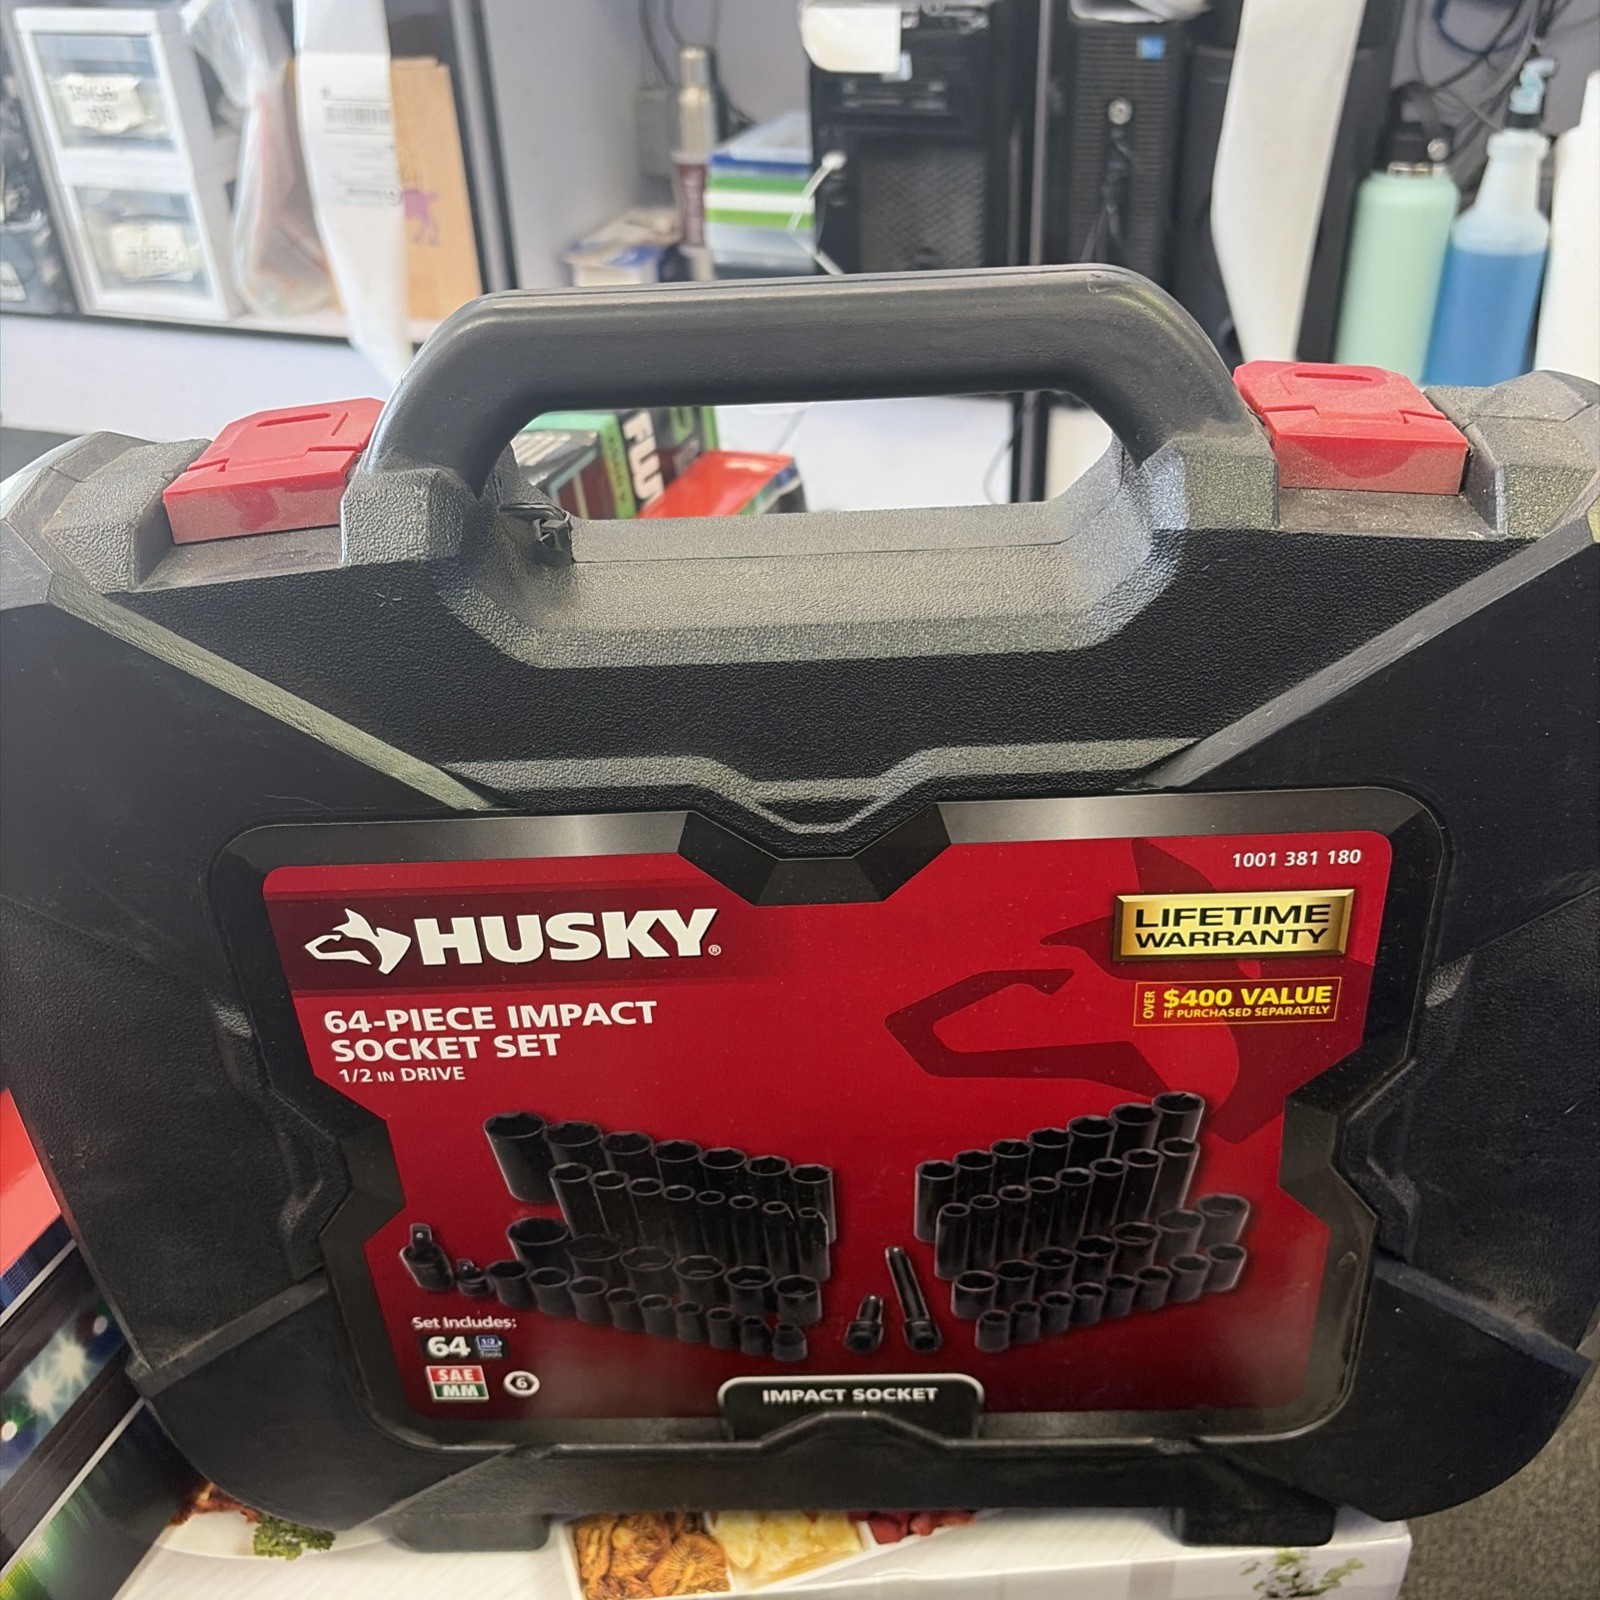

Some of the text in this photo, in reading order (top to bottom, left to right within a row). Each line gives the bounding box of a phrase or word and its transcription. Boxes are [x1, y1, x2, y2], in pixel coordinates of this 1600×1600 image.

[1232, 849, 1362, 868] 1001 381 180
[1135, 904, 1332, 928] LIFETIME
[1135, 927, 1329, 948] WARRANTY
[1143, 990, 1156, 1019] OVER
[1163, 985, 1333, 1009] $400 VALUE
[324, 1000, 658, 1034] 64-PIECE IMPACT
[1163, 1005, 1331, 1019] IF PURCHASED SEPARATELY
[331, 1033, 561, 1062] SOCKET SET
[338, 1066, 466, 1083] 1/2 IN DRIVE
[411, 1315, 517, 1329] Set Includes:
[427, 1336, 471, 1358] 64
[438, 1369, 475, 1381] SAE
[515, 1377, 528, 1389] 6
[442, 1385, 480, 1397] MM
[762, 1387, 939, 1404] IMPACT SOCKET
